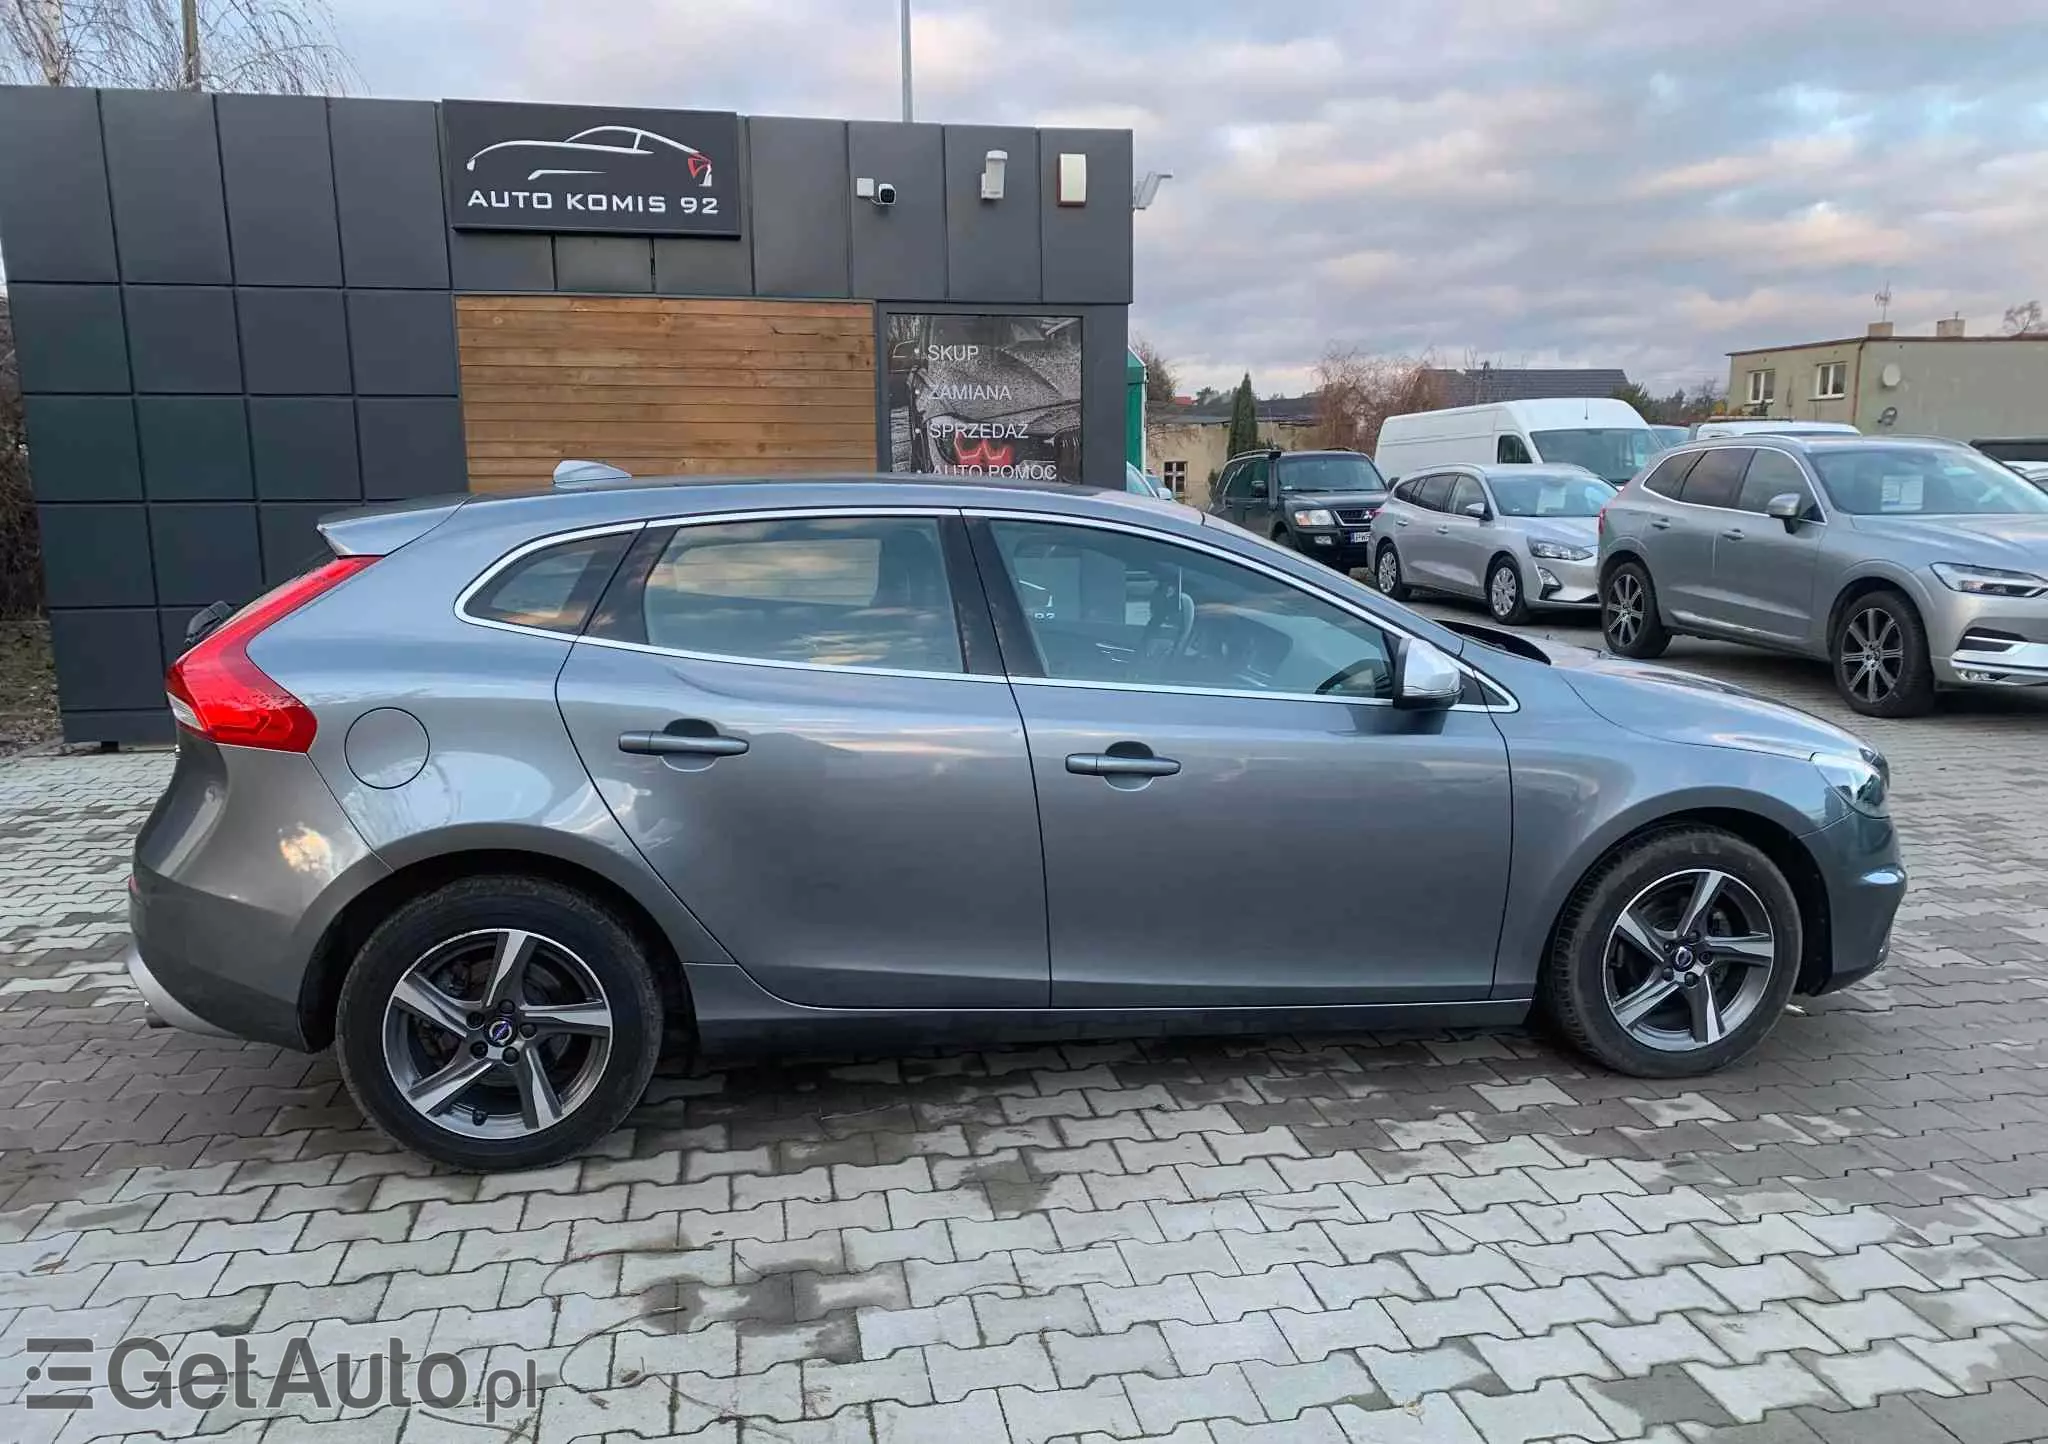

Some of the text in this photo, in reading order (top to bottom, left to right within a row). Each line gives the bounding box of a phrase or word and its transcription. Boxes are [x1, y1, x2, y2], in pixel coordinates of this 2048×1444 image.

[468, 190, 719, 215] AUTO KOMIS 92
[927, 345, 979, 361] SKUP
[928, 384, 1013, 401] ZAMIANA
[988, 465, 1057, 480] POMOC
